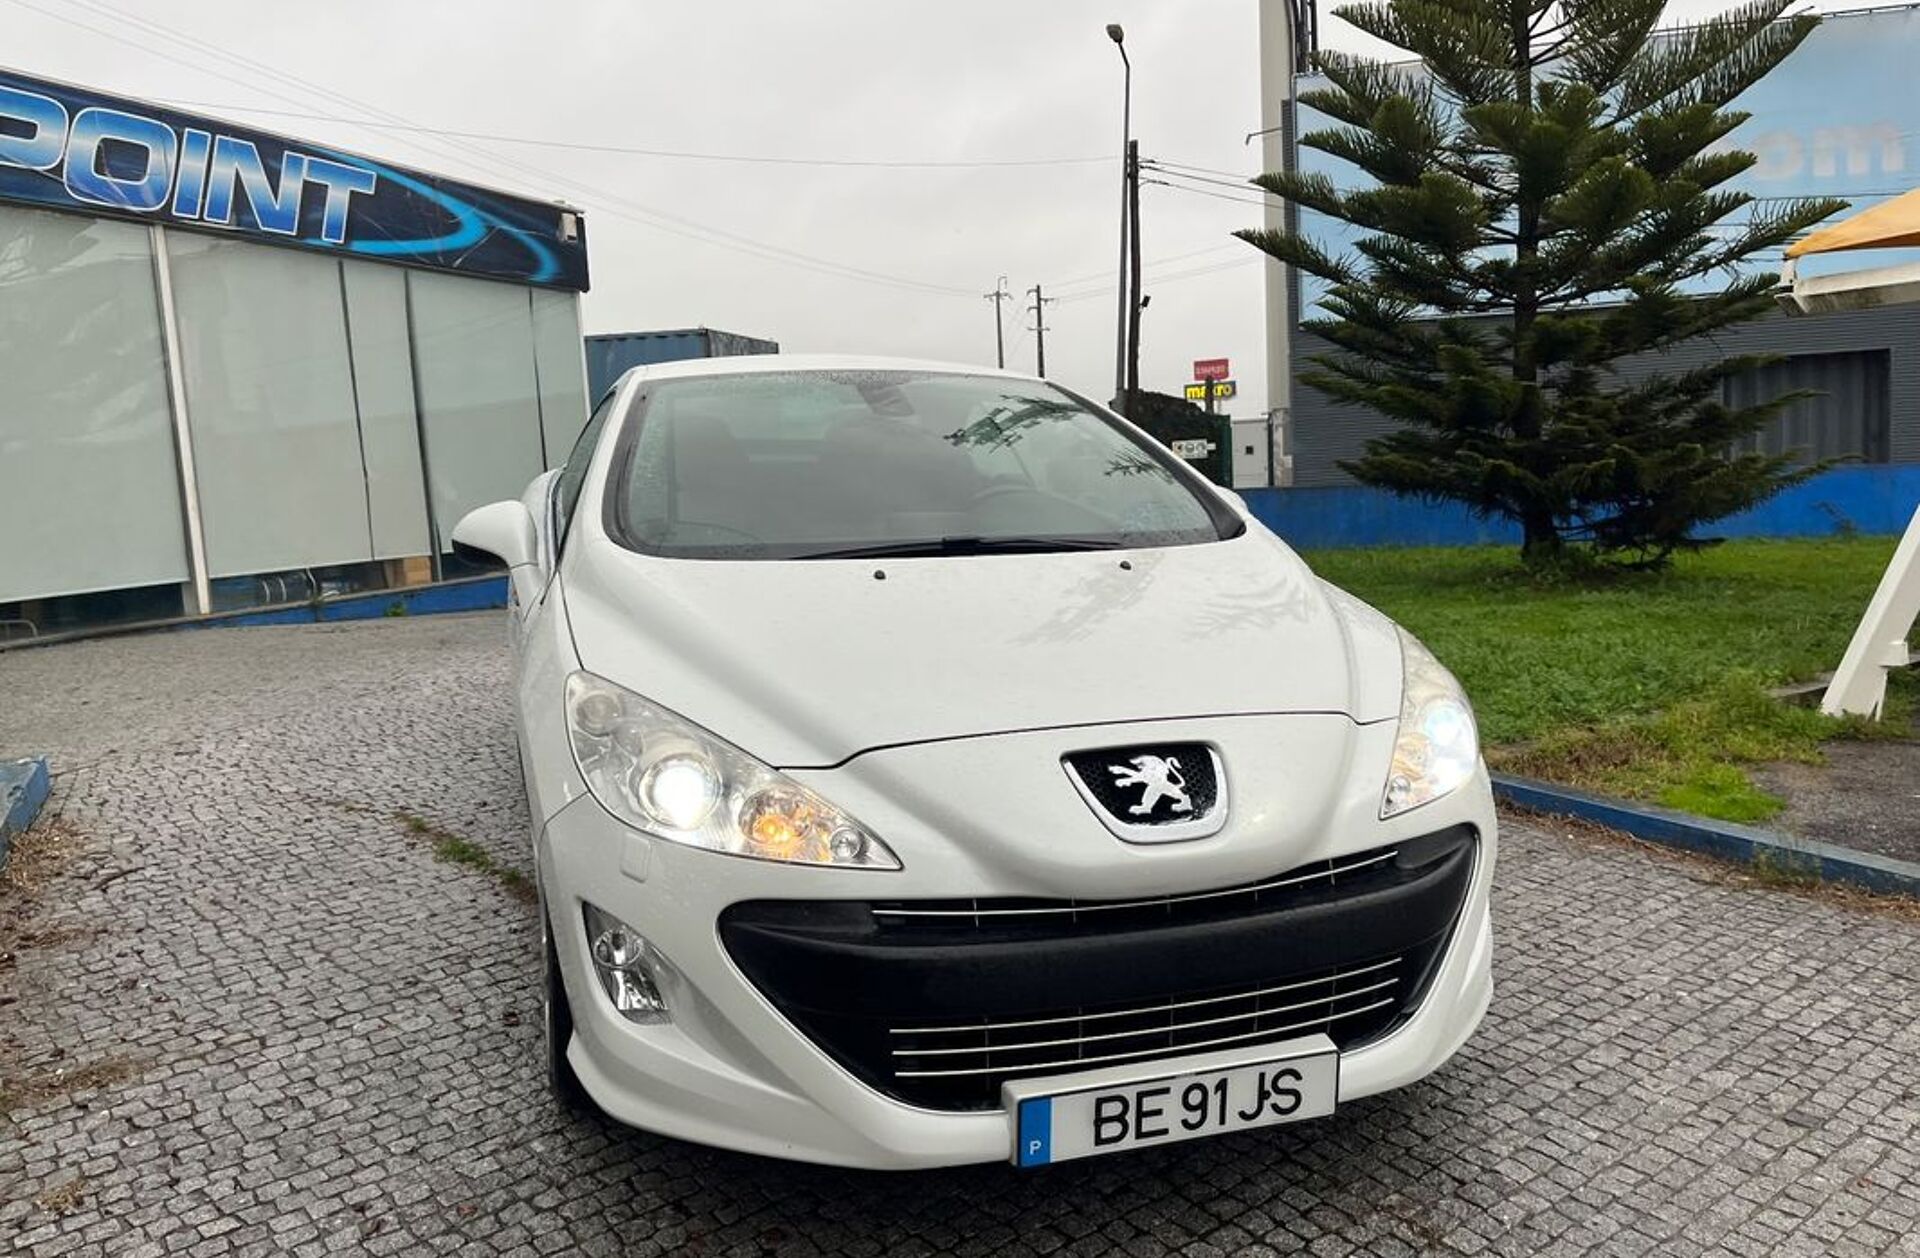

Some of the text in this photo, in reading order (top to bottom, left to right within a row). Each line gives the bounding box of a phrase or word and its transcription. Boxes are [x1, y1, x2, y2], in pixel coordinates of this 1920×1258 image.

[0, 85, 376, 244] POINT
[1093, 1068, 1303, 1147] BE 91 JS
[1029, 1140, 1042, 1155] P
